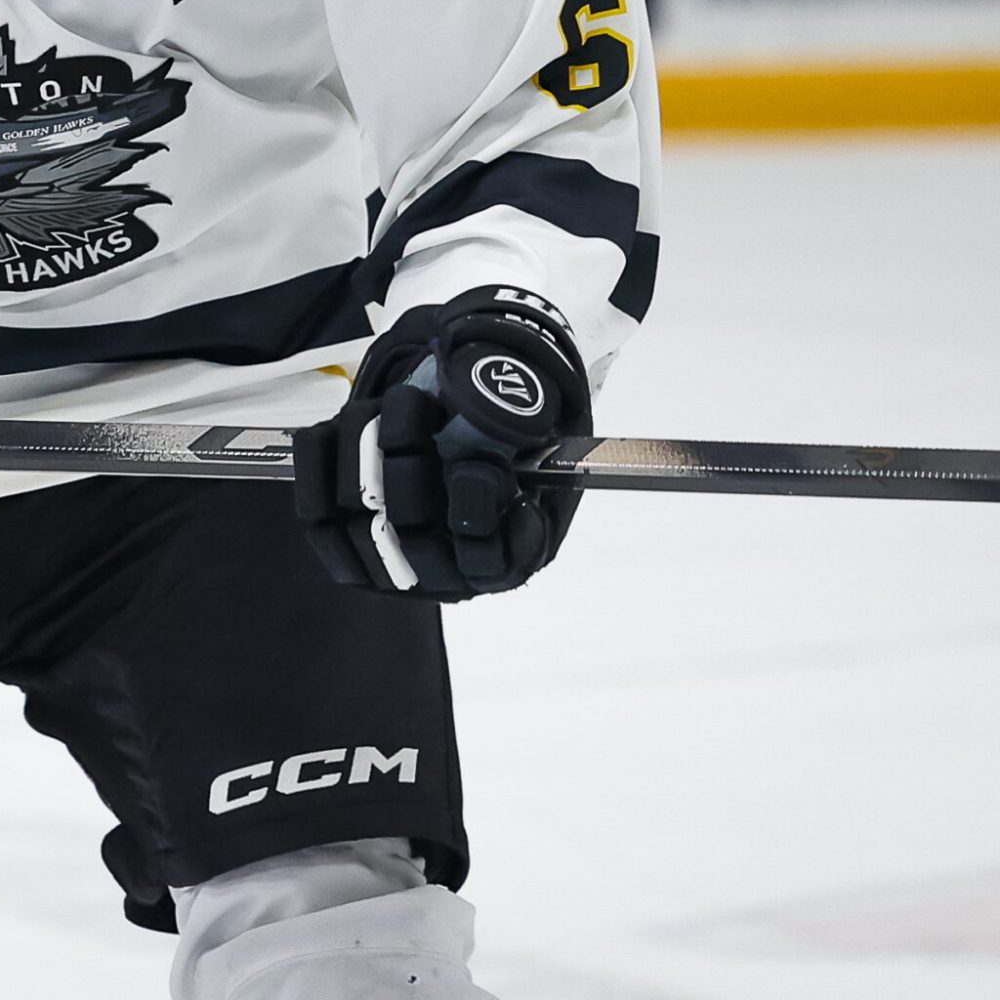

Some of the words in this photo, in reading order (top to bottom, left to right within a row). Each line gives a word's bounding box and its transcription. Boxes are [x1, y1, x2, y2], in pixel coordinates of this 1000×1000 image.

[2, 125, 50, 140] GOLDEN
[53, 115, 94, 134] HAWKS
[4, 229, 133, 284] HAWKS
[208, 745, 420, 816] CCM
